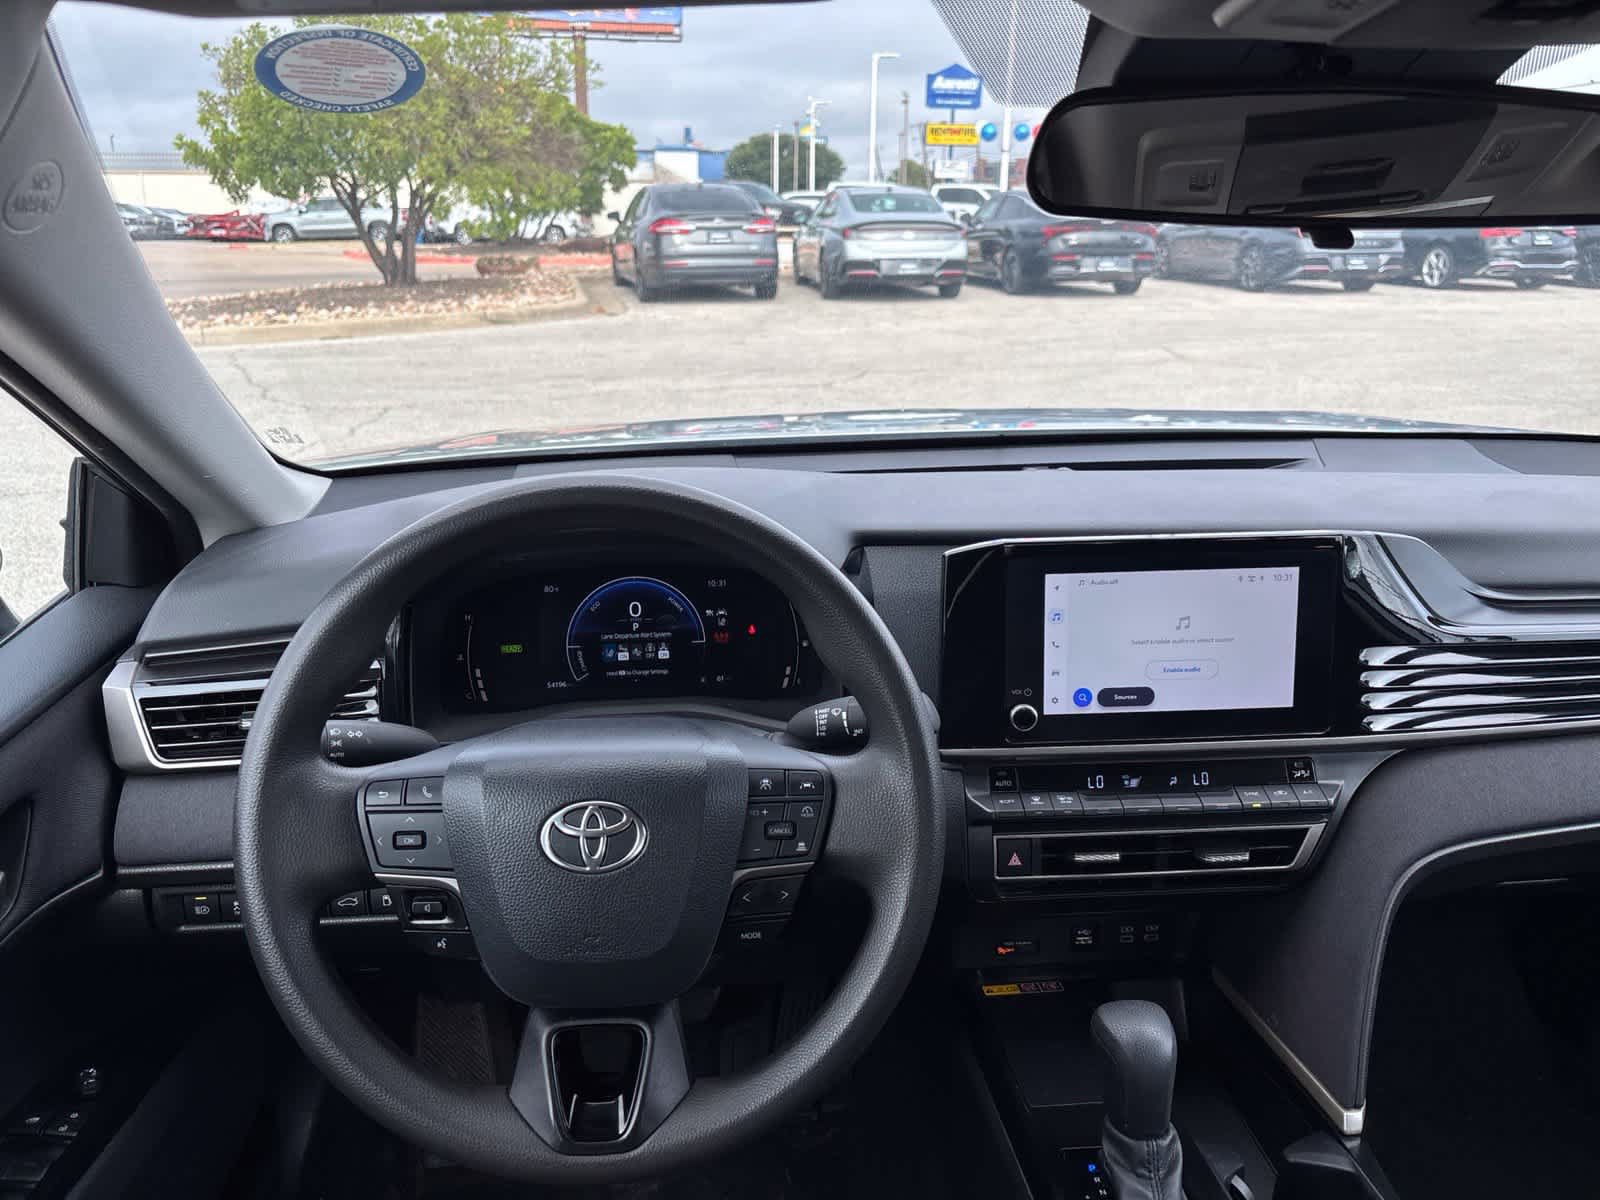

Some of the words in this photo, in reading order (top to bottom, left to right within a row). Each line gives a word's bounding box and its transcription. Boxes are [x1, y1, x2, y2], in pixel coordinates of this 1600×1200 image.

[1273, 573, 1293, 582] 10:31
[628, 601, 642, 618] 0
[632, 623, 639, 632] P
[614, 632, 640, 641] Departure
[1113, 693, 1137, 701] Sources
[994, 779, 1013, 787] AUTO
[1087, 775, 1104, 789] LO
[1192, 772, 1209, 786] LO
